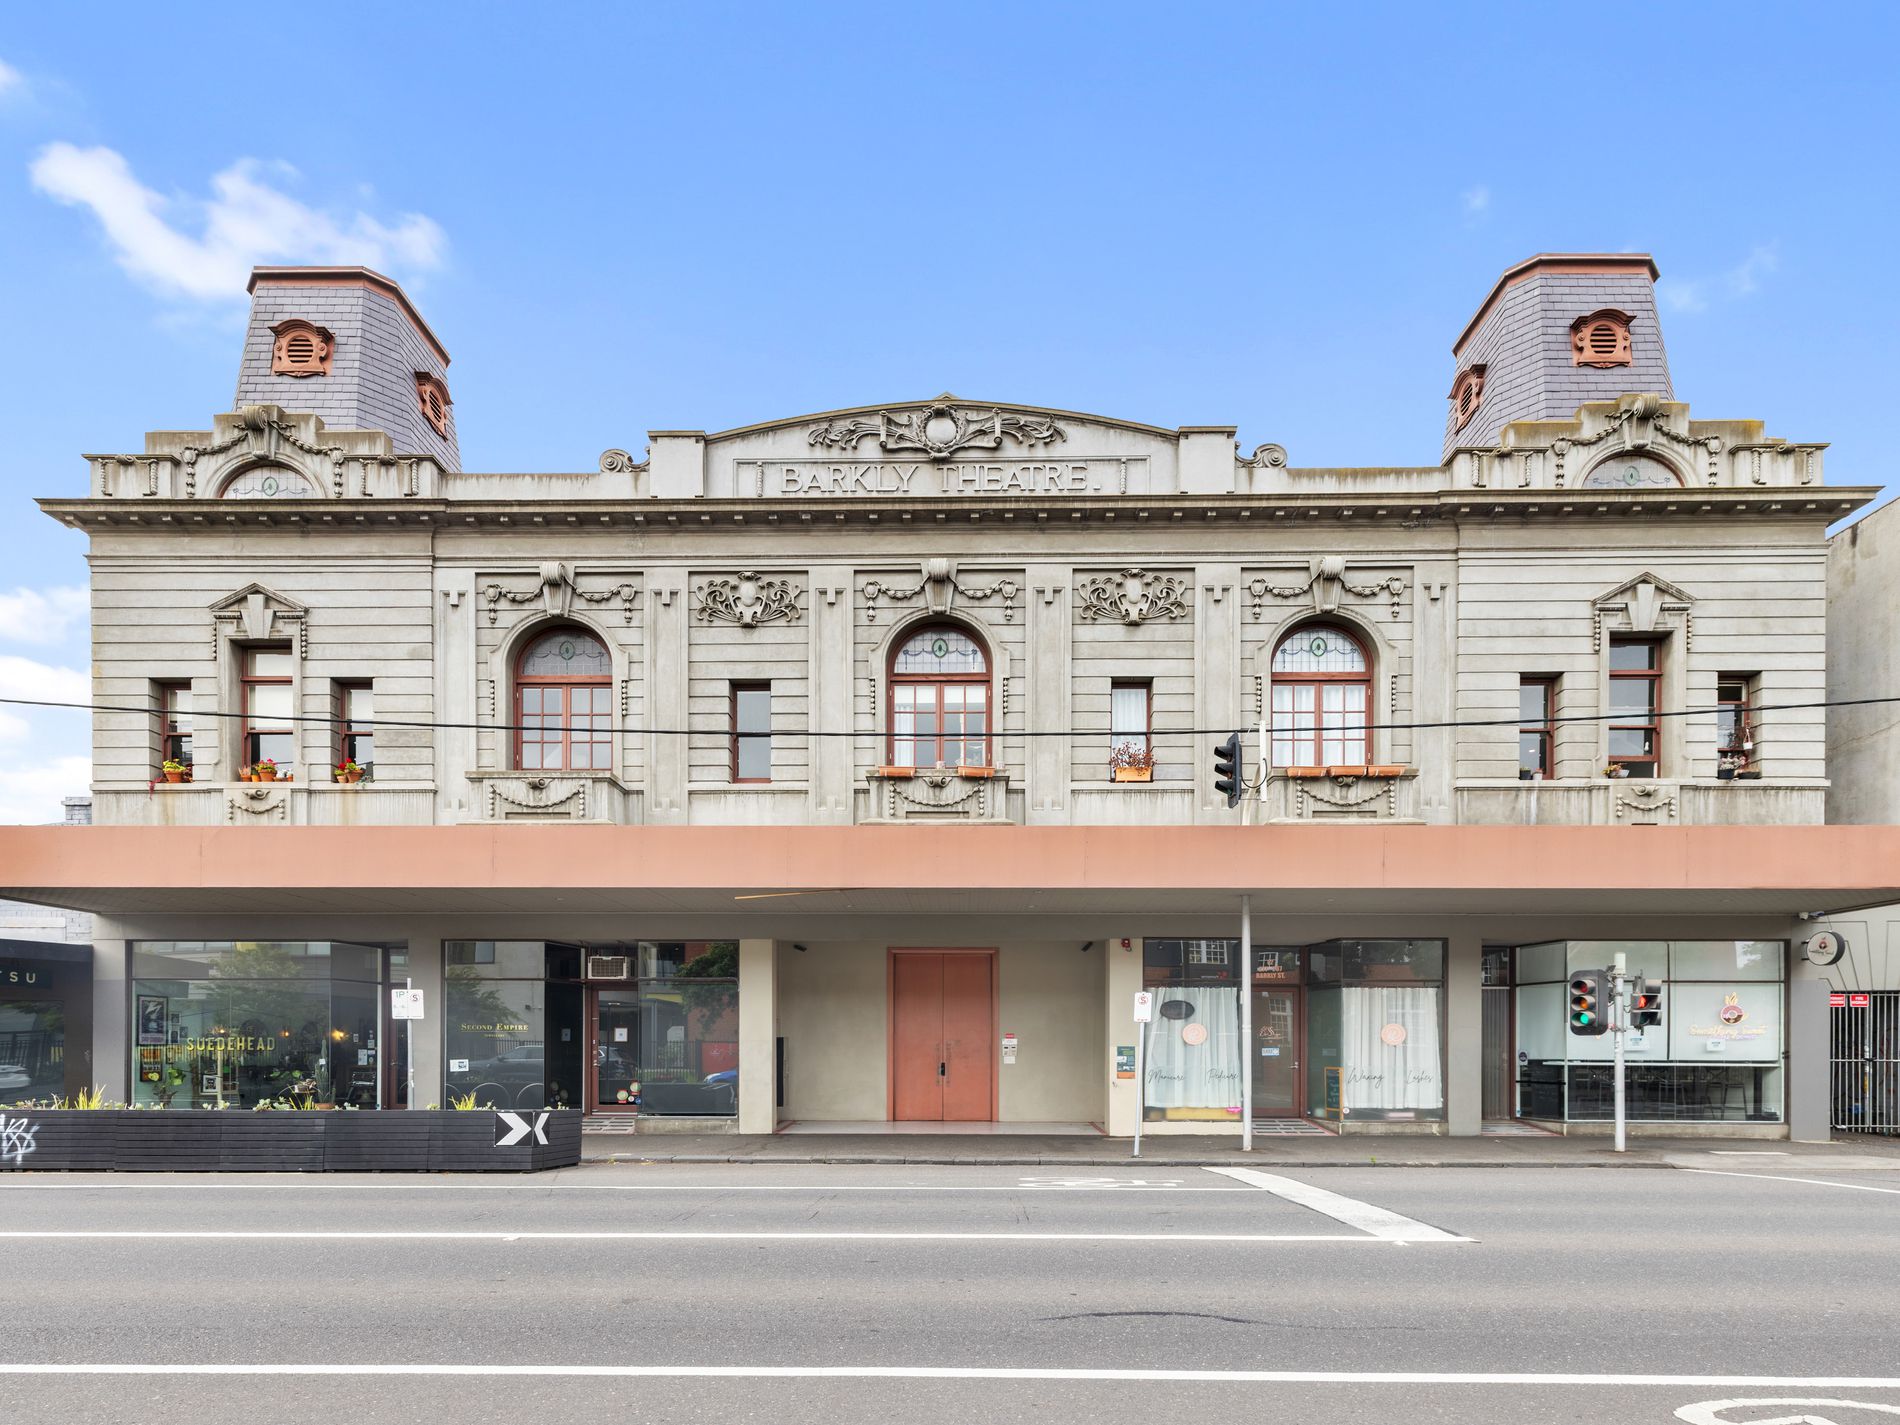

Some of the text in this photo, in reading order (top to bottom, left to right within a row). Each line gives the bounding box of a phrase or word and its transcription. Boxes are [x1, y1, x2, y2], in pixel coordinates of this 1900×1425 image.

[781, 464, 1101, 493] BARKLY THEATRE.
[0, 970, 36, 984] SU
[496, 1023, 529, 1031] EMPIRE
[186, 1037, 276, 1051] SUEDEHEAD
[1147, 1068, 1186, 1085] Manicure
[1347, 1067, 1385, 1089] Waxing
[1406, 1070, 1434, 1085] Lashes
